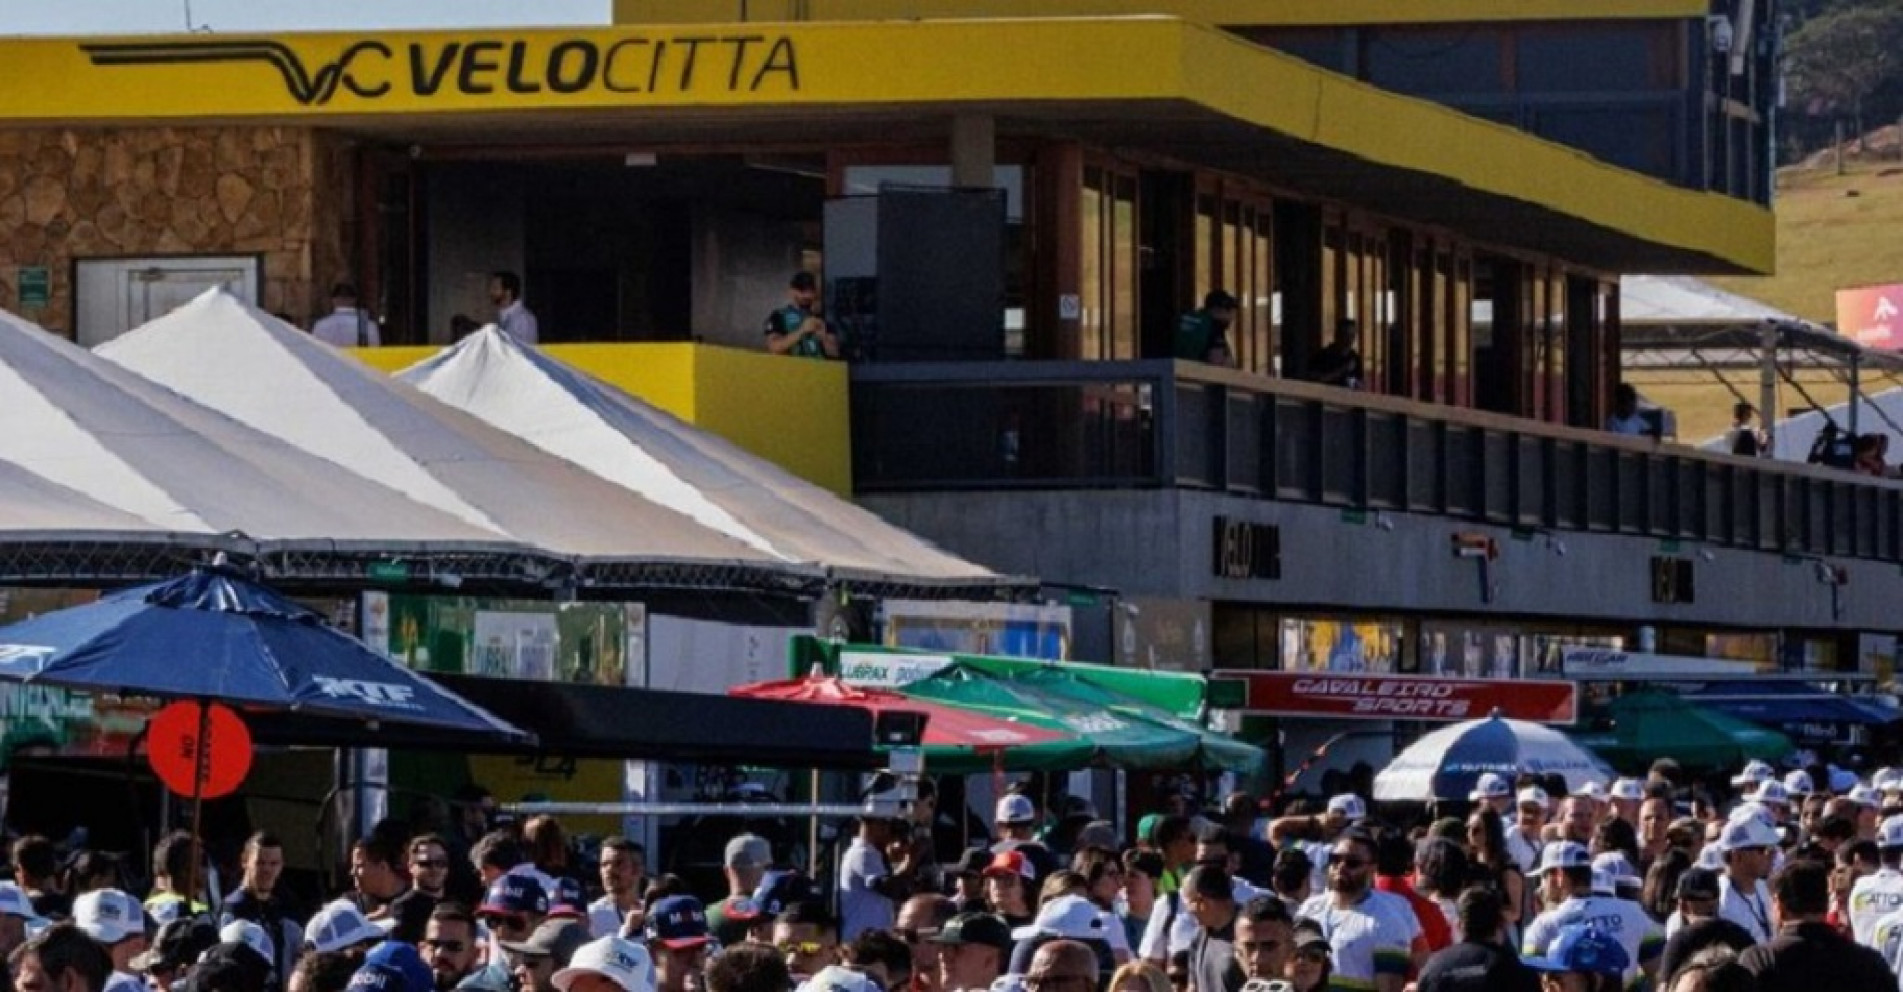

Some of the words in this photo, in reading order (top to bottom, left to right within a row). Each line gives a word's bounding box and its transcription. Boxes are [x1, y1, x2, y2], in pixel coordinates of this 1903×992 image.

[408, 35, 800, 96] VELOCITTA
[1292, 678, 1454, 698] CAVALEIRO
[1352, 698, 1471, 715] SPORTS
